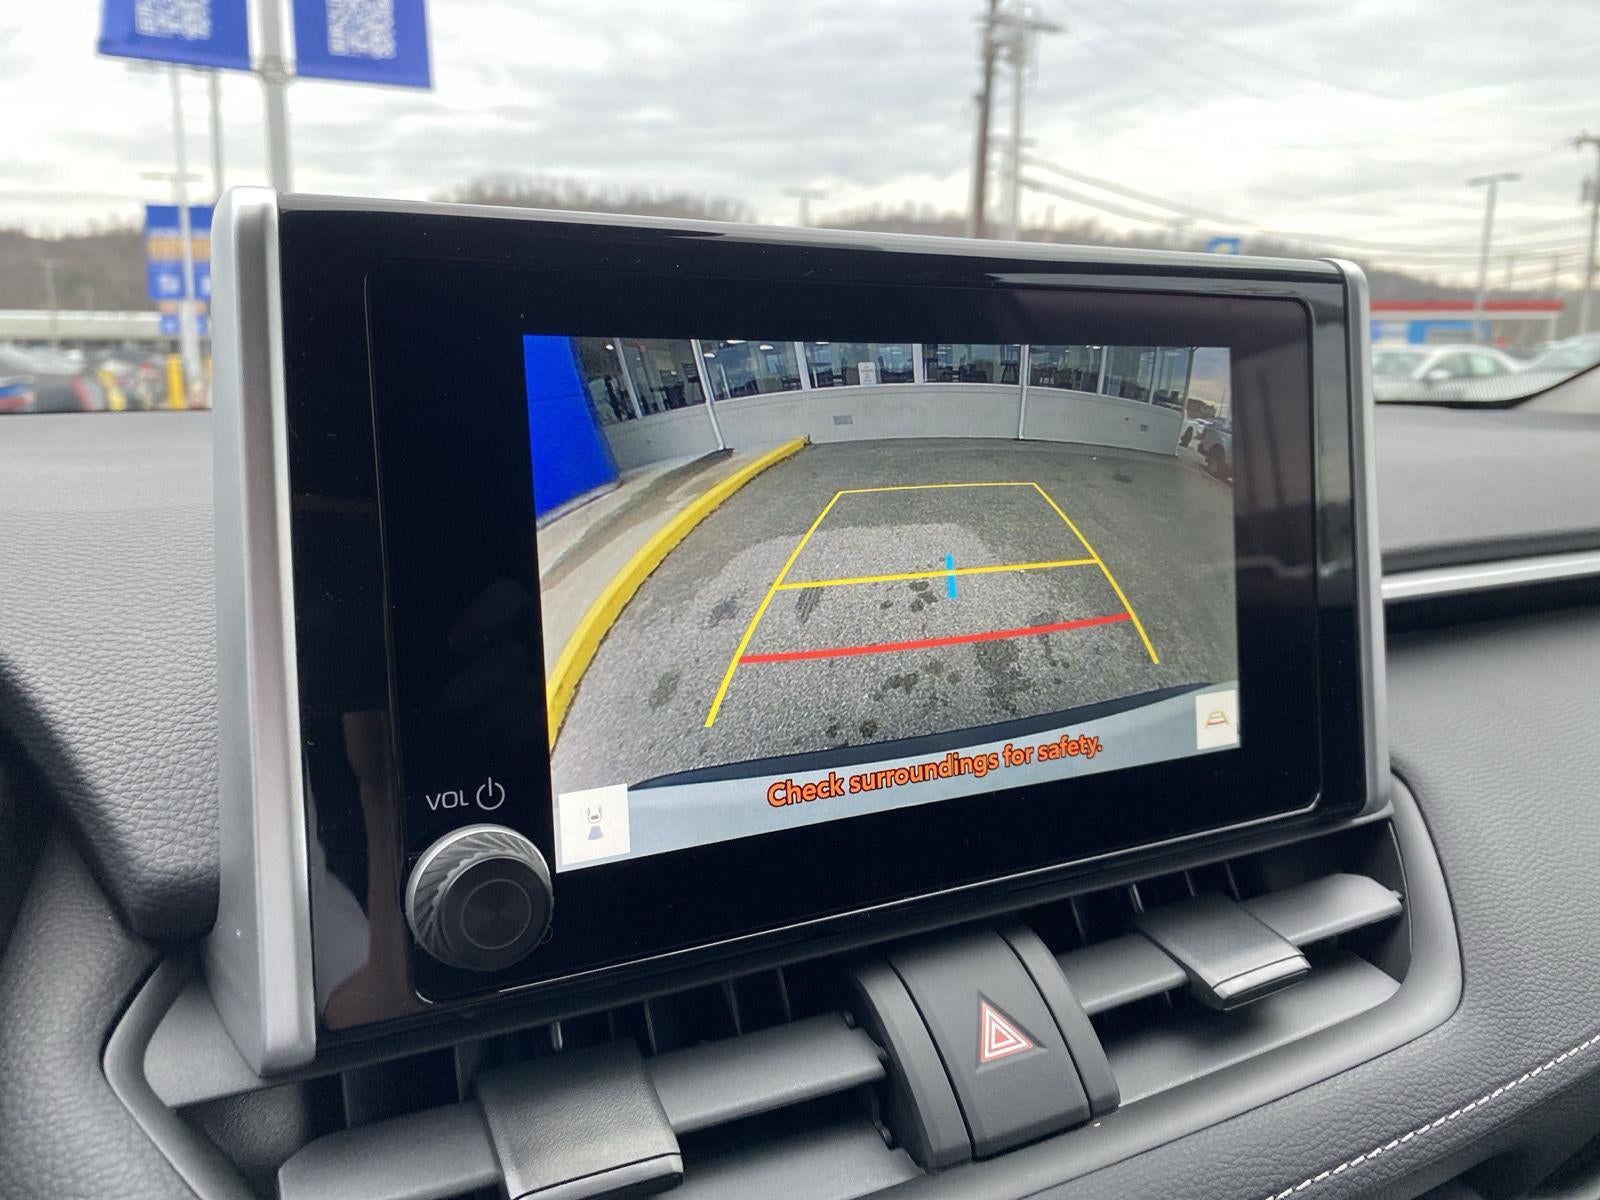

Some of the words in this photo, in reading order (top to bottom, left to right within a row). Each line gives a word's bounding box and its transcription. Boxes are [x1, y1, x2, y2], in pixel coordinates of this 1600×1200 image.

[767, 772, 844, 807] Check
[849, 752, 999, 792] surroundings
[1003, 744, 1033, 766] for
[1037, 735, 1103, 762] safety.
[425, 790, 469, 811] VOL
